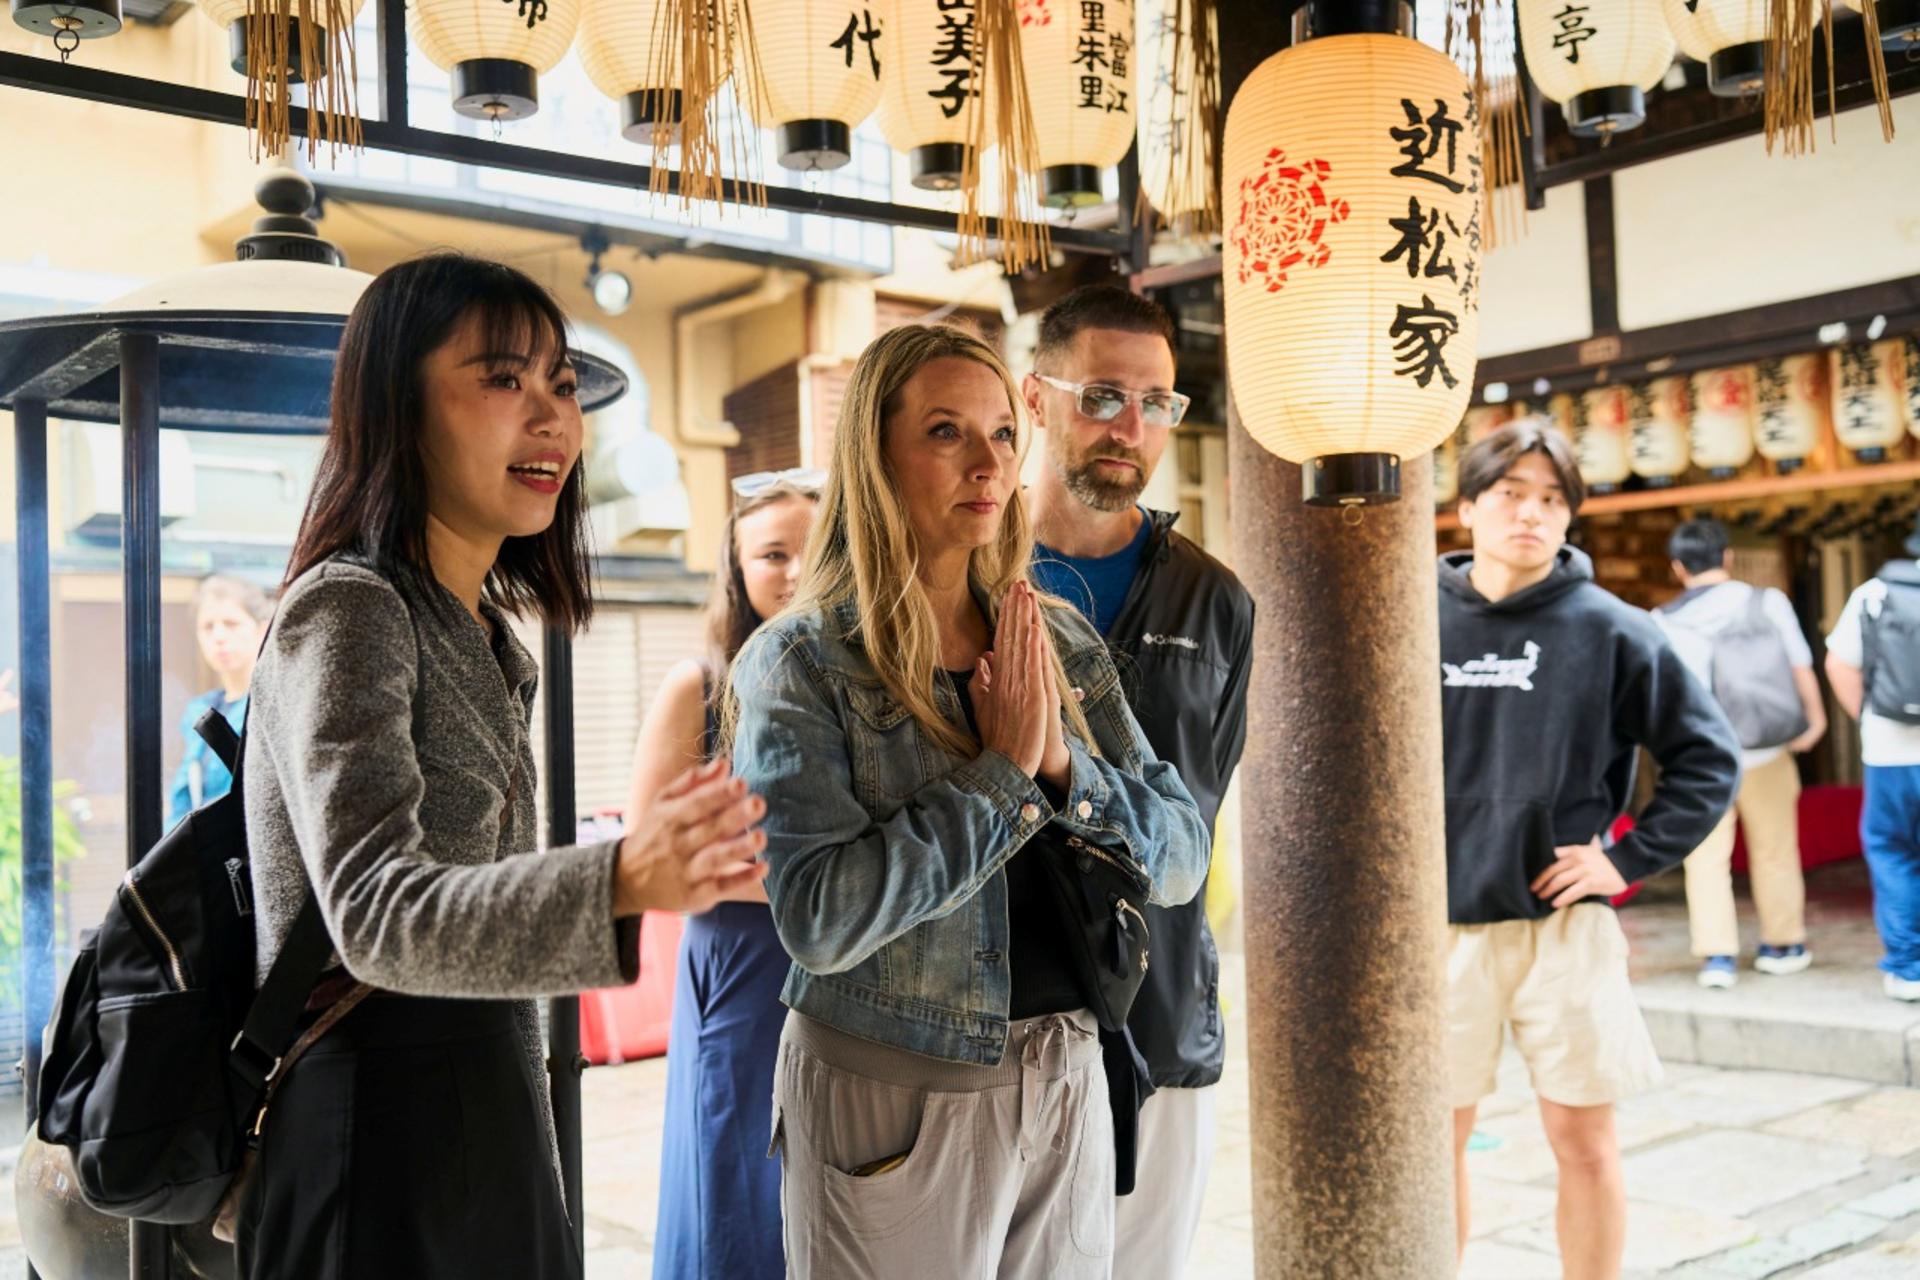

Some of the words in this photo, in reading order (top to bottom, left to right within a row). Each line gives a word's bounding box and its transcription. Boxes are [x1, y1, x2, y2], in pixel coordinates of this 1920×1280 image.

[829, 9, 883, 81] 代
[928, 0, 984, 118] 美子
[1552, 5, 1597, 64] 亭
[1380, 98, 1464, 390] 近松家
